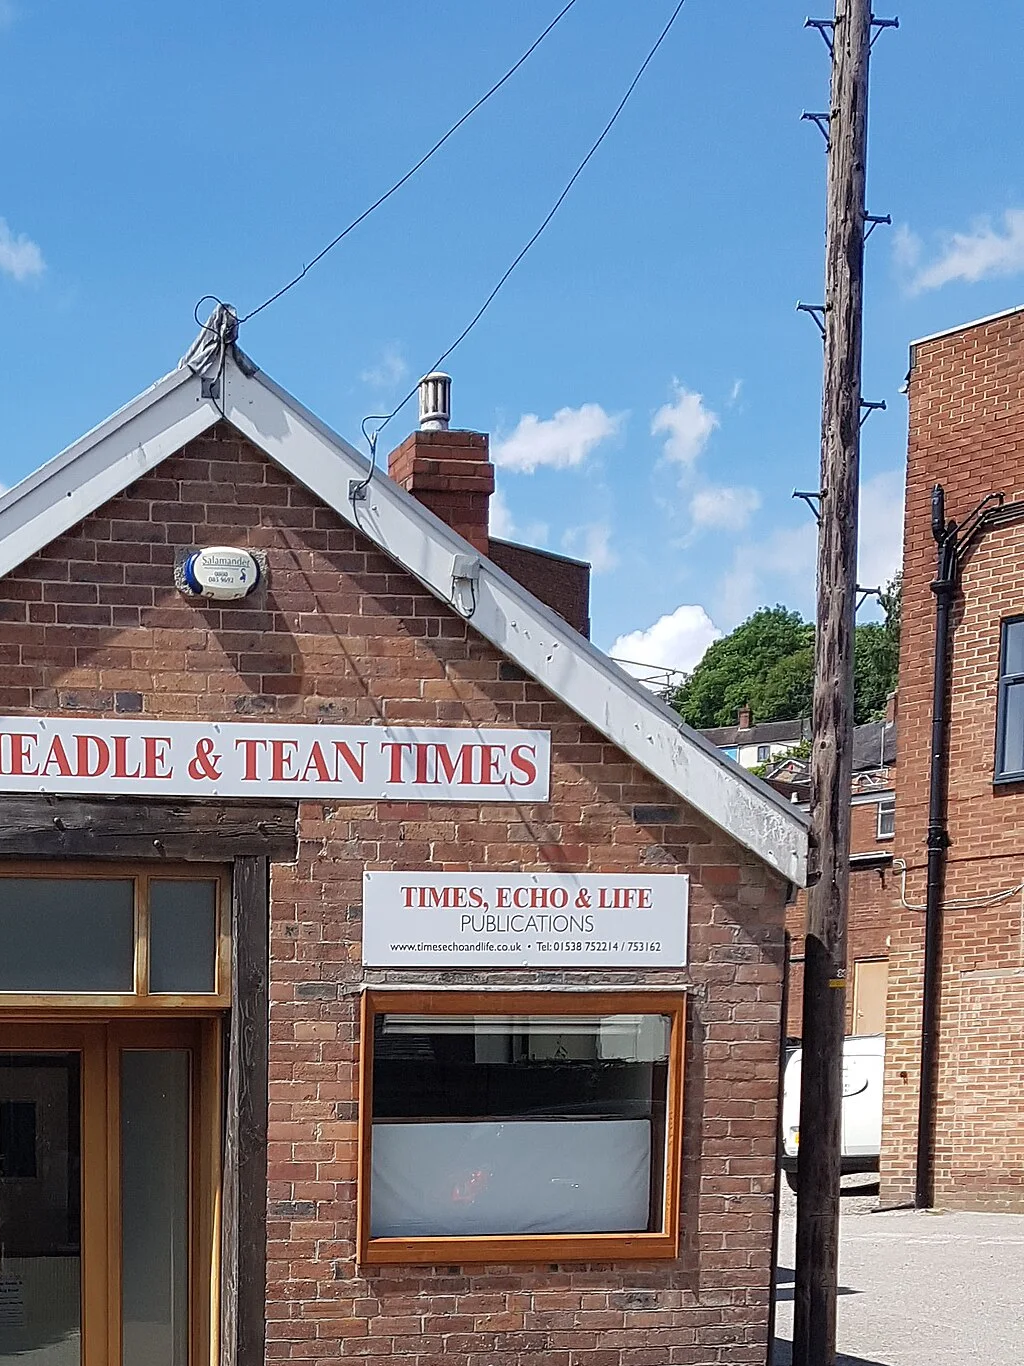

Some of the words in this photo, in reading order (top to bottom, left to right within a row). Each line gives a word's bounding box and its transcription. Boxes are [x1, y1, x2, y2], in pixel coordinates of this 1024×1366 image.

[202, 555, 251, 567] Salamander
[187, 737, 224, 781] &
[235, 738, 369, 783] TEAN
[380, 742, 537, 786] TIMES
[401, 886, 489, 912] TIMES,
[495, 887, 569, 909] ECHO
[574, 887, 592, 909] &
[597, 887, 653, 909] LIFE
[460, 914, 594, 933] PUBLICATIONS
[390, 941, 522, 952] www.timesechoandlife.co.uk
[536, 941, 552, 952] Tel:
[553, 941, 582, 952] 01538
[584, 941, 618, 952] 752214
[620, 941, 625, 952] /
[627, 941, 662, 952] 753162
